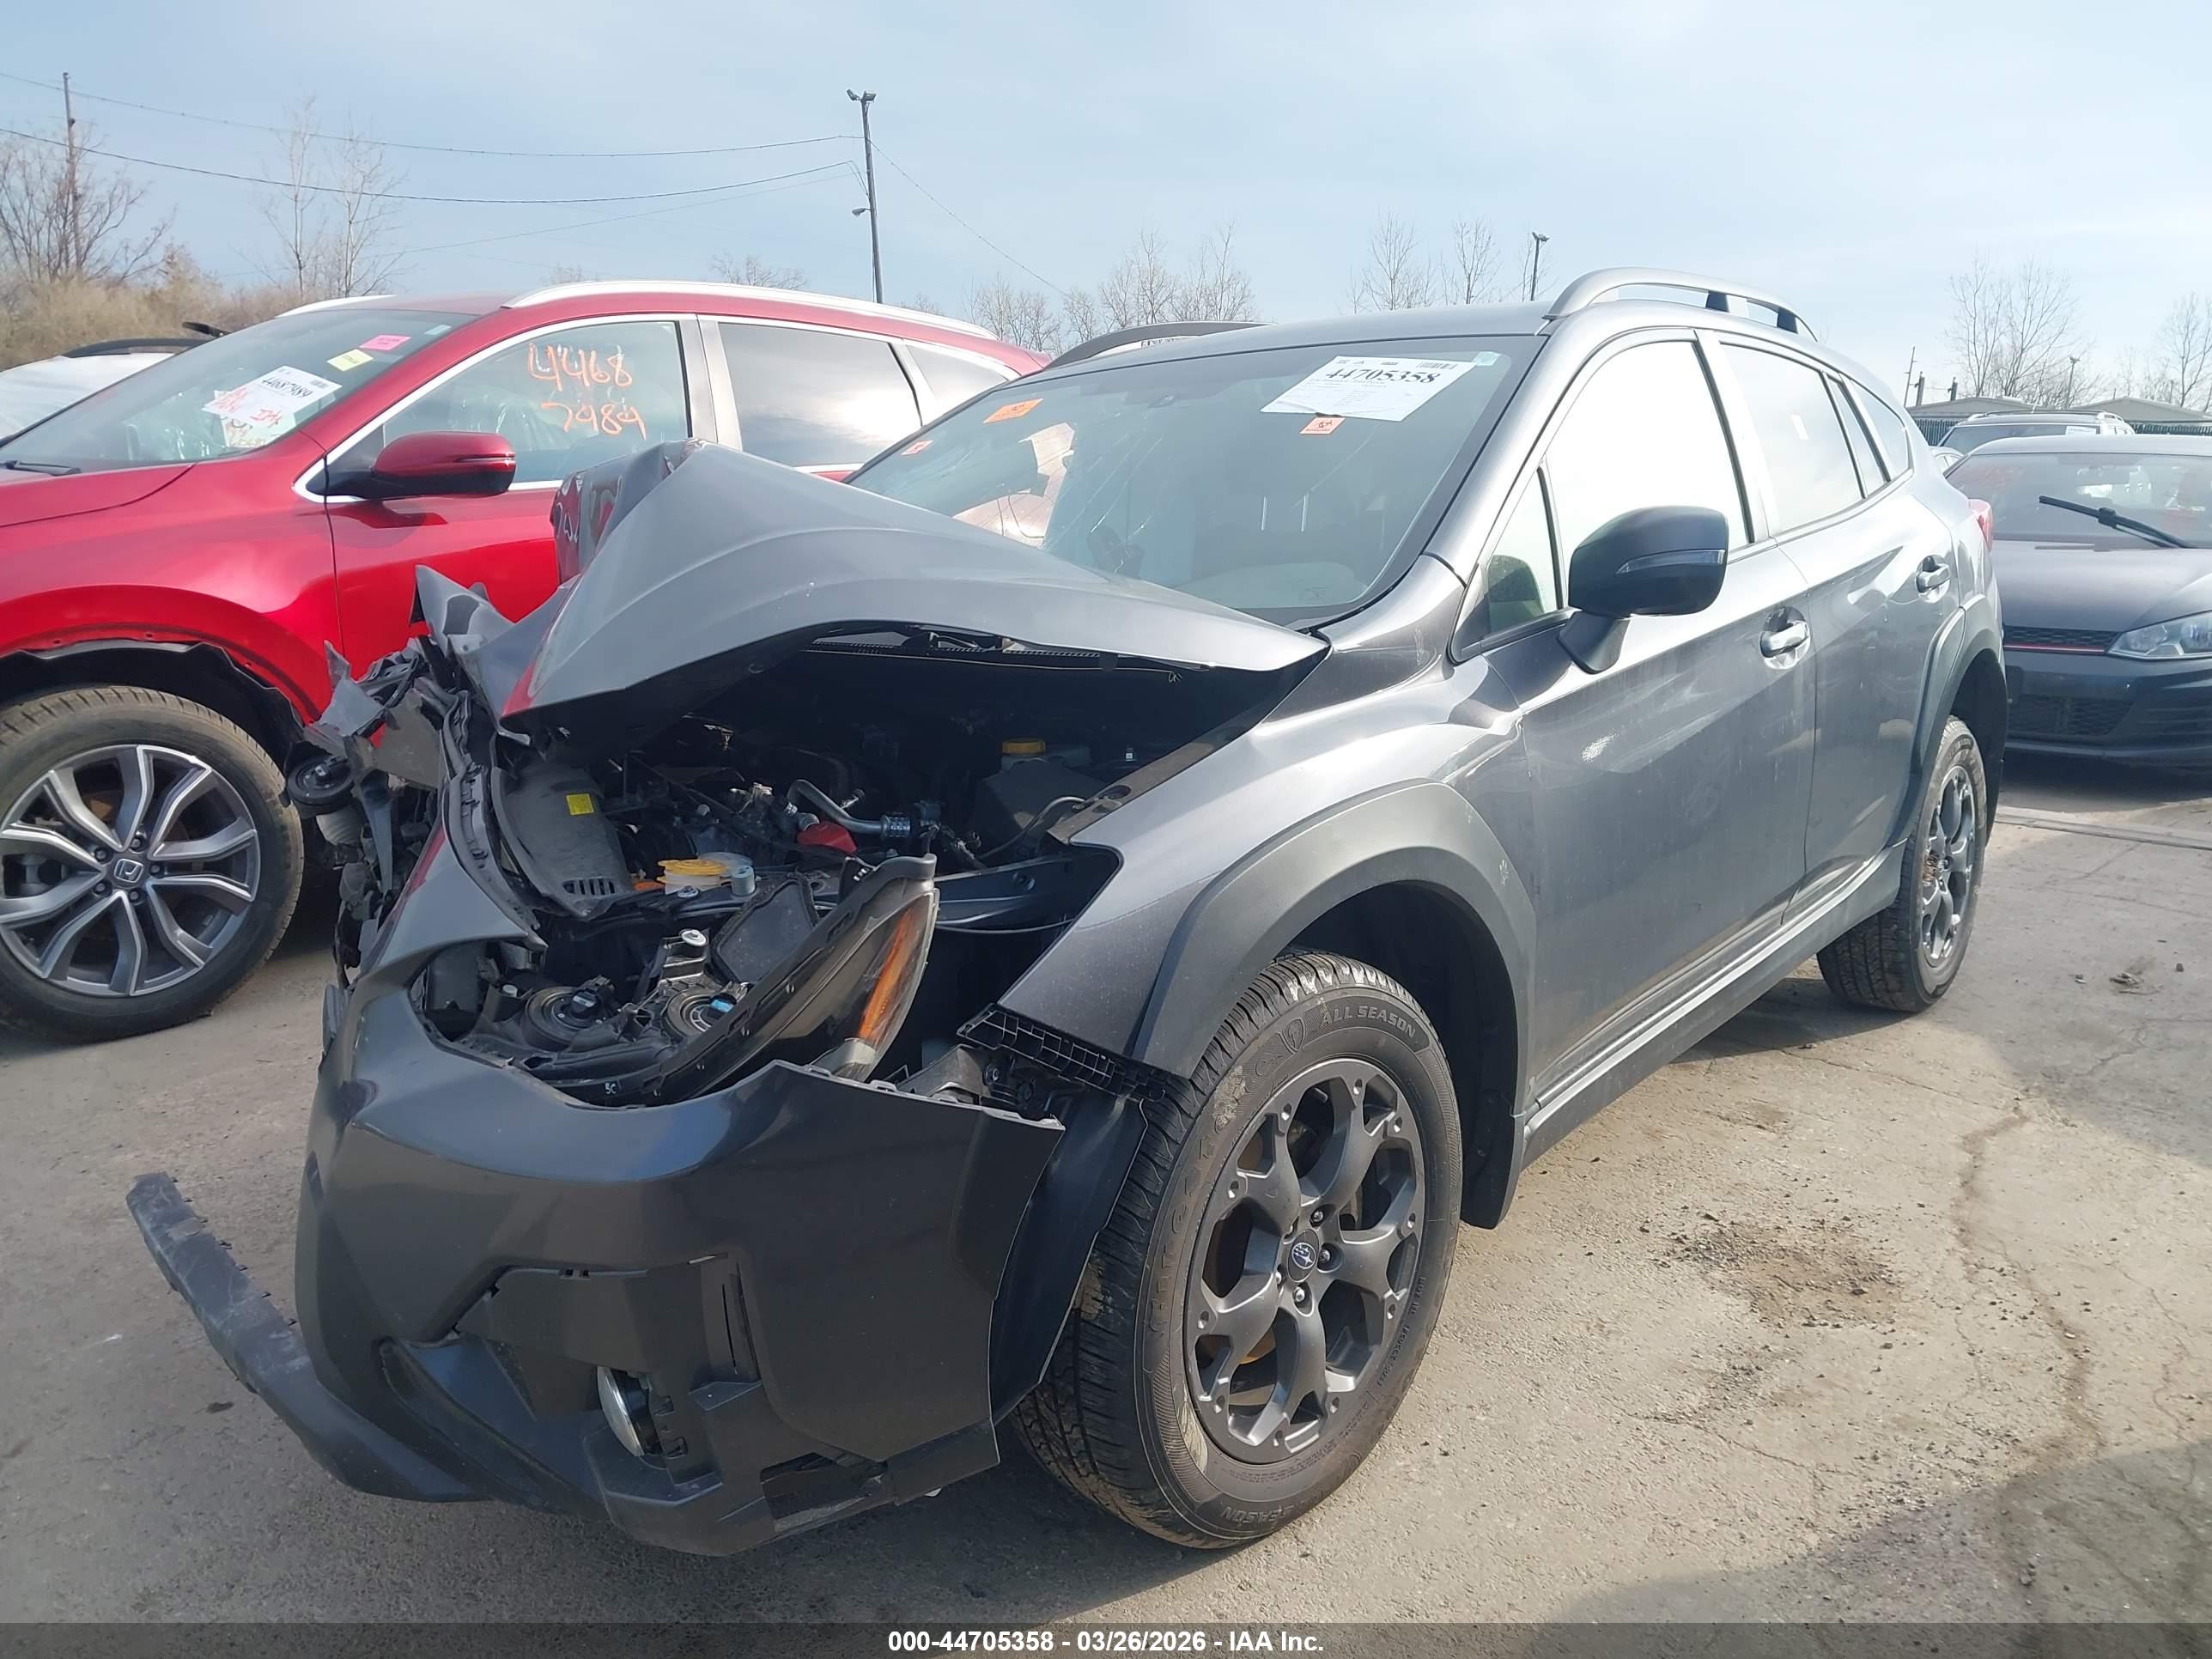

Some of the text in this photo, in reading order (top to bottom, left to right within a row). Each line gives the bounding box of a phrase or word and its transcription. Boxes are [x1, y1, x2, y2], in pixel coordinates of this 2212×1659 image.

[528, 343, 633, 392] 4468
[1326, 368, 1442, 384] 44705358
[541, 404, 647, 441] 7989
[1321, 1006, 1416, 1038] ALL SEASON
